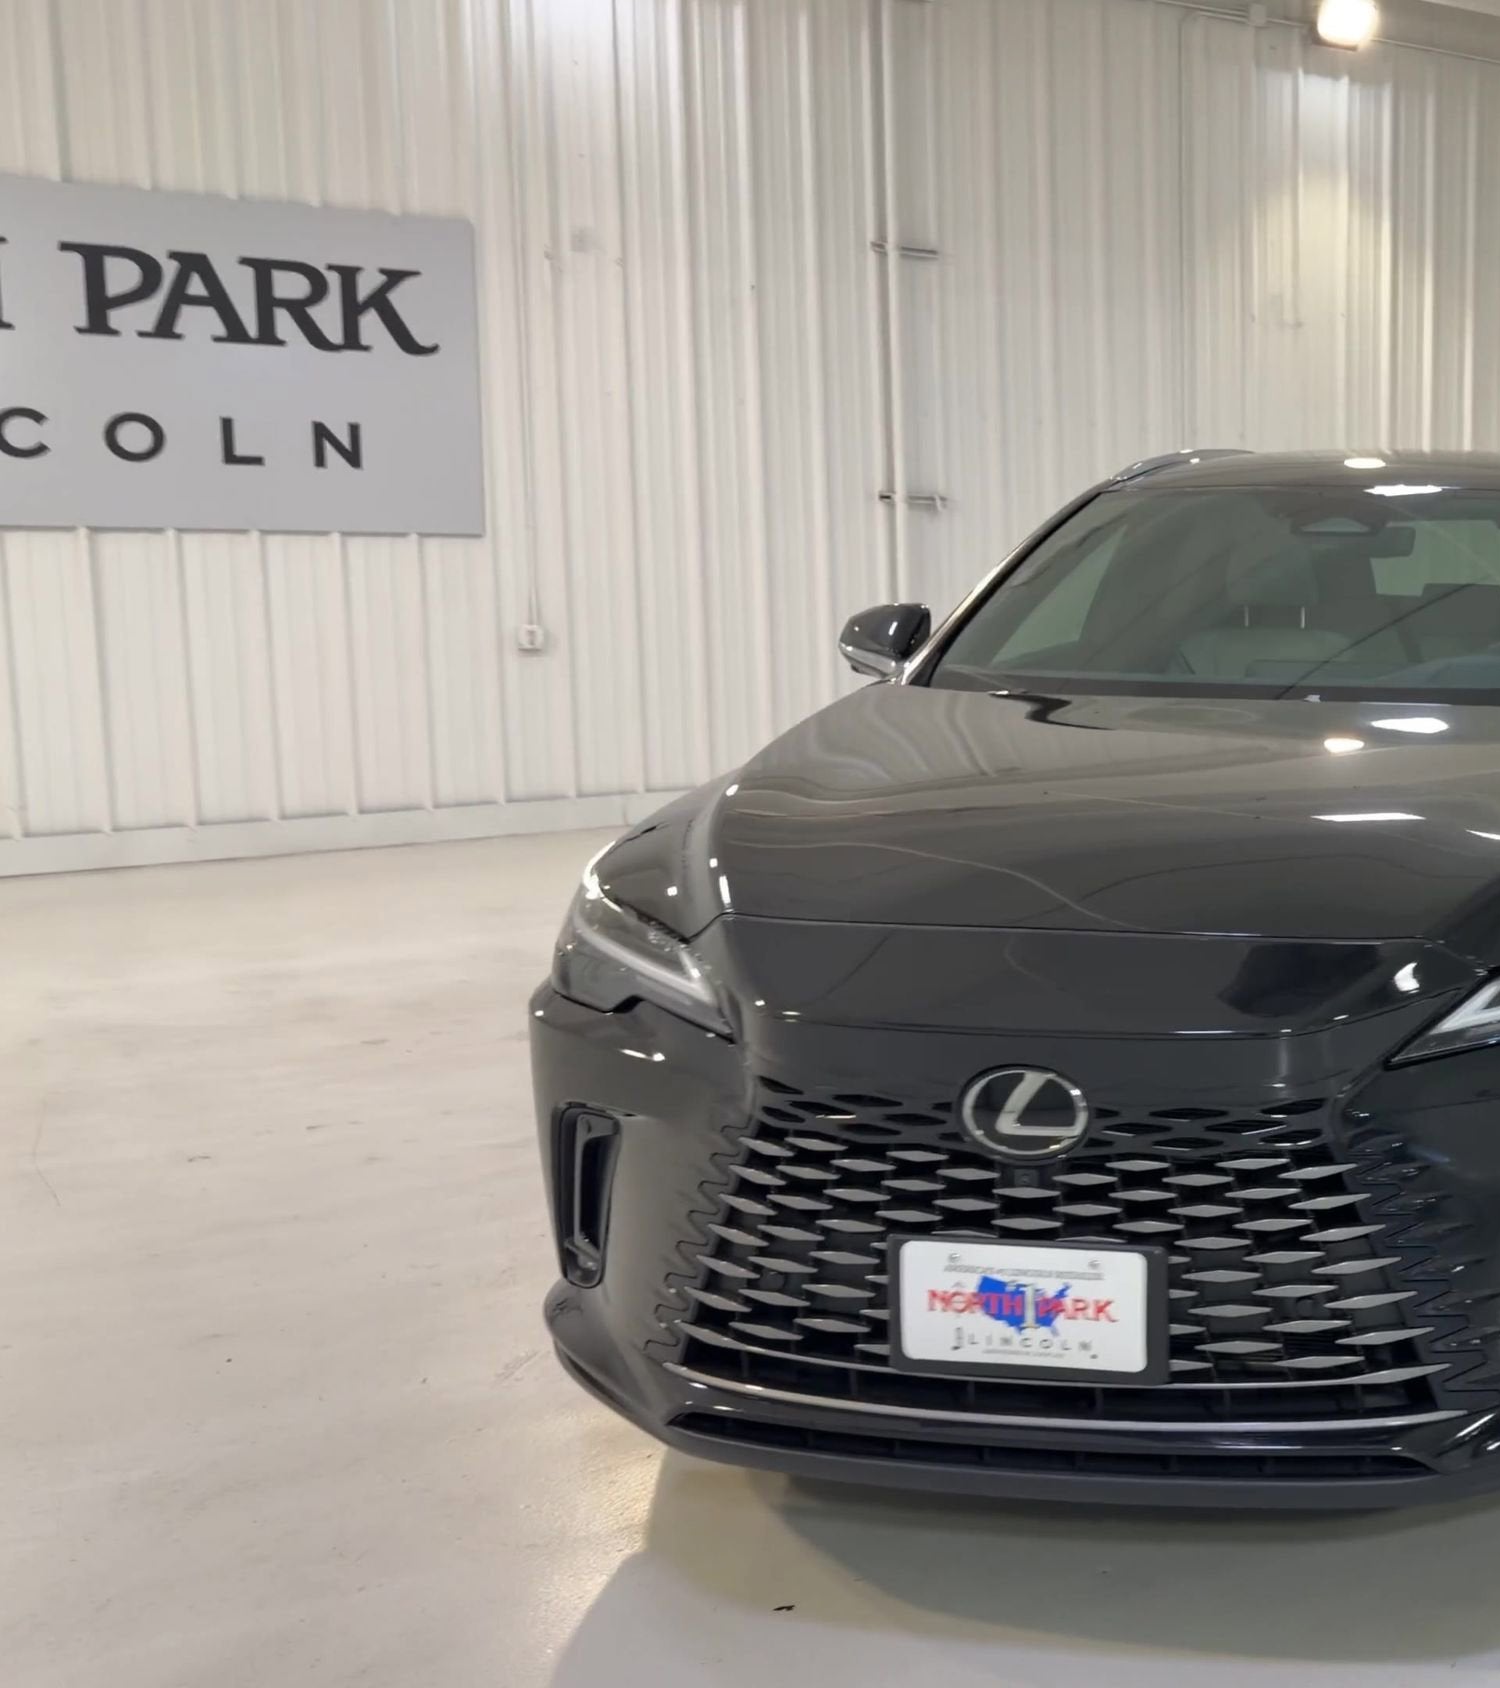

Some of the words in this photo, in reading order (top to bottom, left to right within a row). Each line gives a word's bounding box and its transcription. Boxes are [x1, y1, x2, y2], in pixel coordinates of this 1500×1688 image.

[58, 240, 440, 357] PARK
[0, 406, 363, 470] COLN
[927, 1288, 1024, 1317] NORTH
[1038, 1294, 1119, 1323] PARK
[967, 1332, 1093, 1351] LINCOLN
